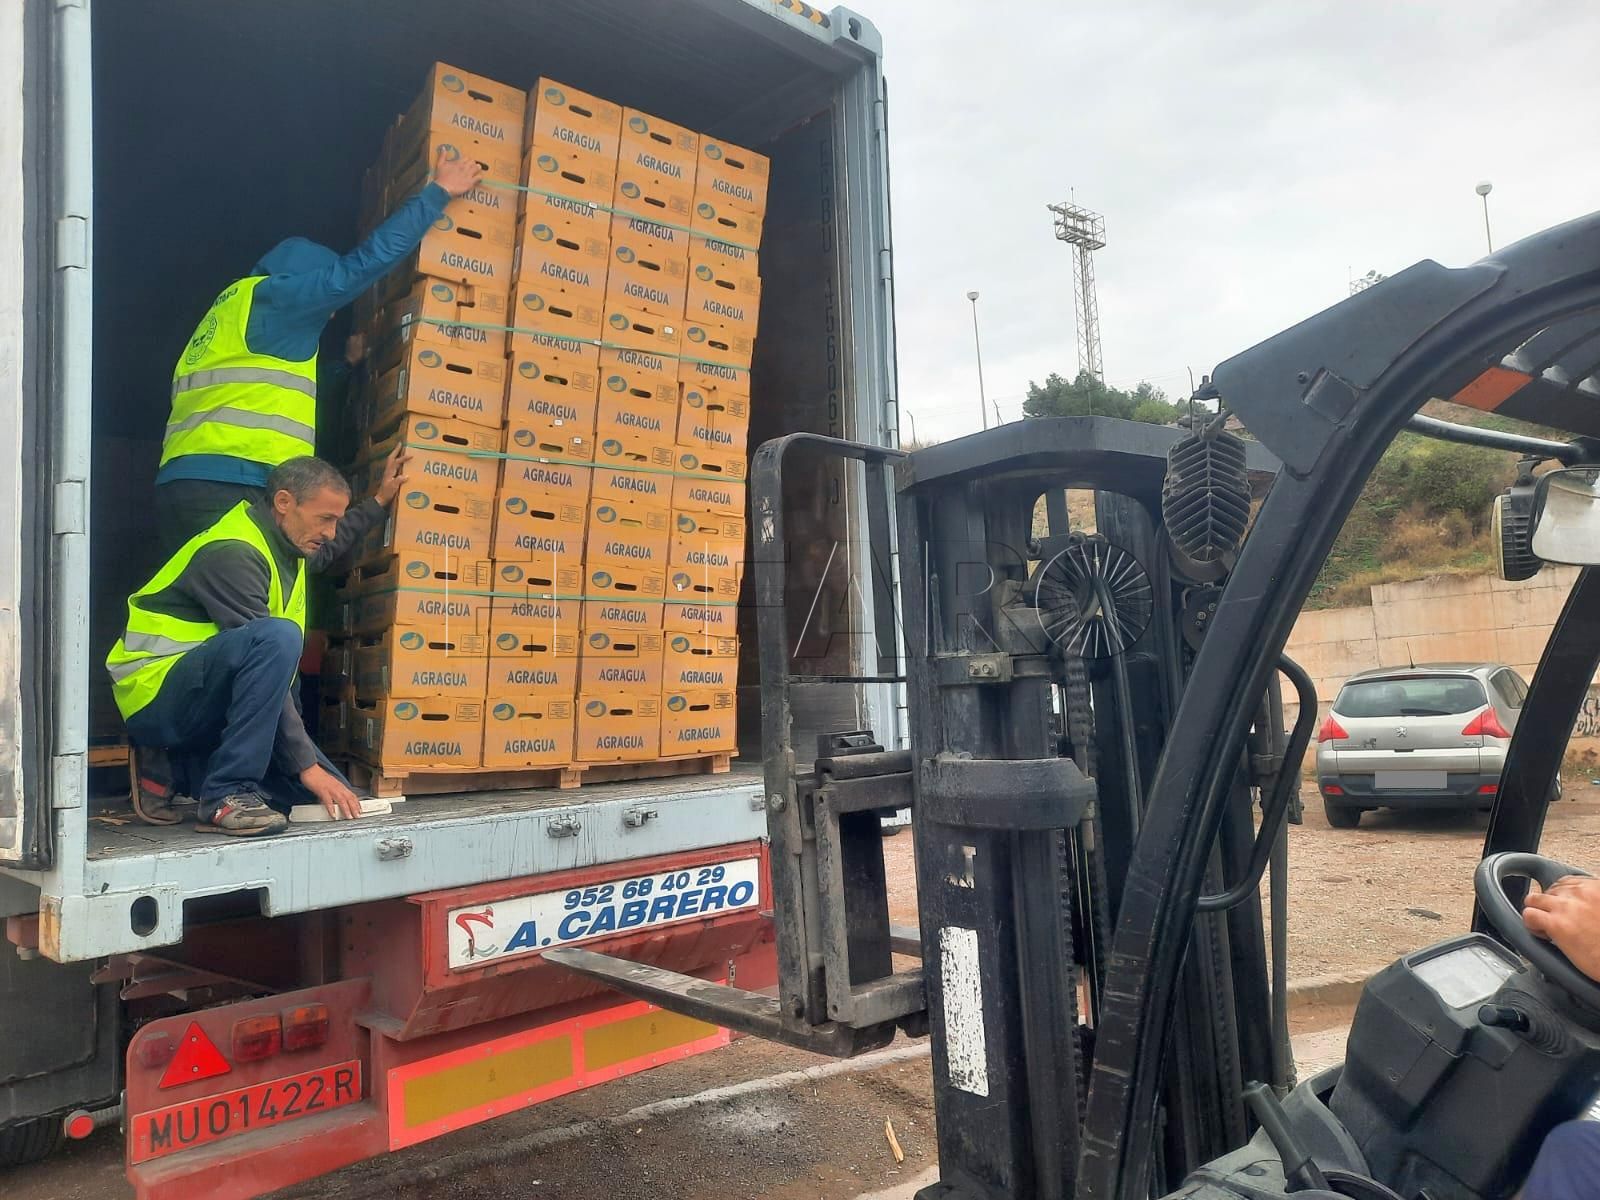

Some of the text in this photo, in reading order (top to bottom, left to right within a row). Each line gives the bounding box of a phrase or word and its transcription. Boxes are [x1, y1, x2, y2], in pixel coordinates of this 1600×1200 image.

[452, 113, 504, 141] AGRAGUA
[553, 126, 601, 152] AGRAGUA
[637, 152, 681, 178] AGRAGUA
[712, 179, 753, 202] AGRAGUA
[546, 195, 594, 218] AGRAGUA
[630, 219, 673, 242] AGRAGUA
[705, 240, 745, 260] AGRAGUA
[441, 252, 494, 276] AGRAGUA
[541, 263, 589, 286] AGRAGUA
[624, 283, 669, 305] AGRAGUA
[703, 300, 744, 320] AGRAGUA
[437, 323, 487, 343] AGRAGUA
[532, 334, 581, 354] AGRAGUA
[617, 351, 663, 371] AGRAGUA
[696, 362, 737, 381] AGRAGUA
[429, 389, 483, 411] AGRAGUA
[528, 400, 577, 420] AGRAGUA
[616, 412, 661, 431] AGRAGUA
[693, 427, 732, 444] AGRAGUA
[424, 461, 478, 482] AGRAGUA
[523, 468, 572, 487] AGRAGUA
[611, 476, 656, 494] AGRAGUA
[689, 487, 731, 504] AGRAGUA
[416, 530, 470, 549] AGRAGUA
[515, 536, 564, 553] AGRAGUA
[605, 543, 651, 559] AGRAGUA
[687, 552, 729, 566] AGRAGUA
[418, 600, 470, 617] AGRAGUA
[512, 604, 561, 619] AGRAGUA
[601, 608, 646, 623] AGRAGUA
[681, 607, 722, 622] AGRAGUA
[412, 672, 467, 686] AGRAGUA
[508, 671, 558, 684] AGRAGUA
[599, 669, 646, 682] AGRAGUA
[680, 671, 723, 683] AGRAGUA
[597, 736, 643, 749] AGRAGUA
[678, 728, 720, 740] AGRAGUA
[405, 742, 461, 756] AGRAGUA
[505, 740, 555, 753] AGRAGUA
[564, 866, 726, 911] 952 68 40 29
